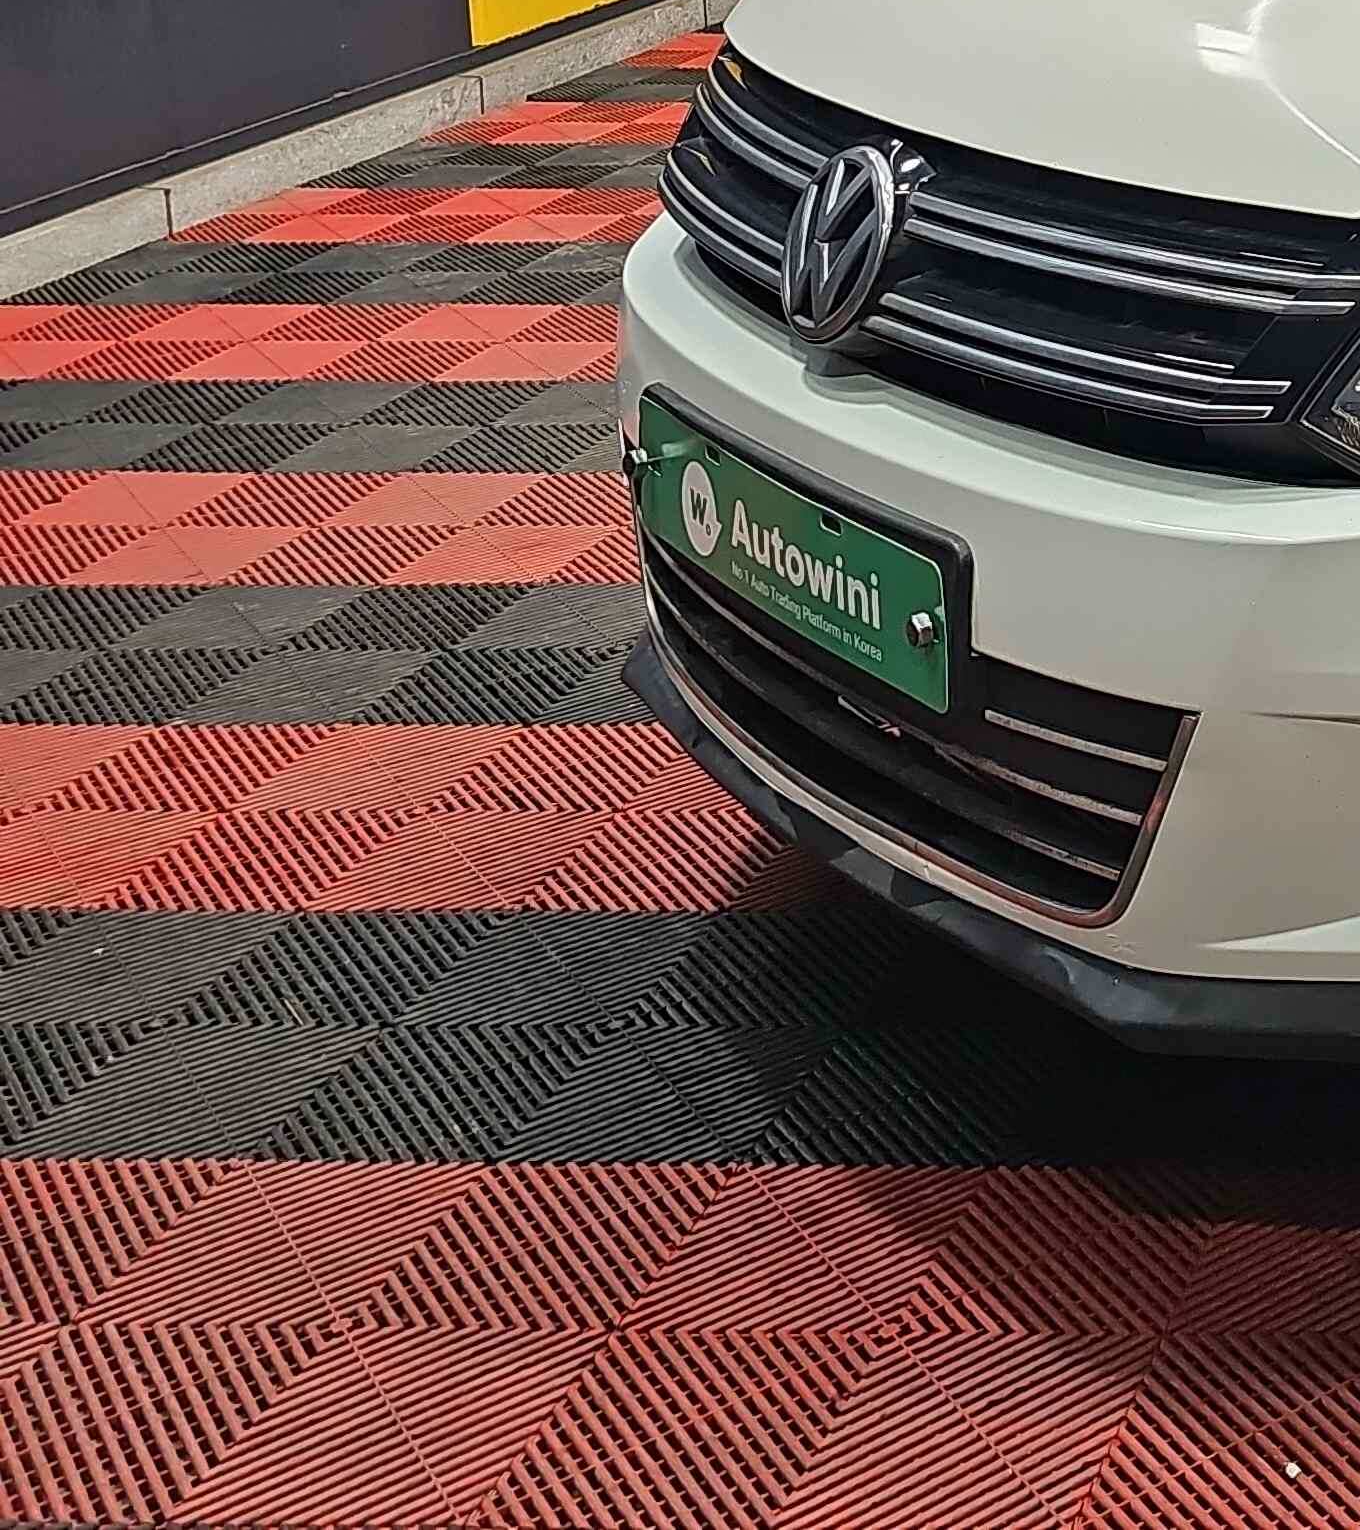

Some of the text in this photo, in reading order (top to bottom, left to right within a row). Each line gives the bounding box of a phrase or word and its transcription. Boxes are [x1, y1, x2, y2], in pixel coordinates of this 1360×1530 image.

[731, 499, 881, 630] Autowini
[770, 584, 801, 620] Trading
[802, 604, 842, 640] Platform
[853, 633, 882, 663] Korea
